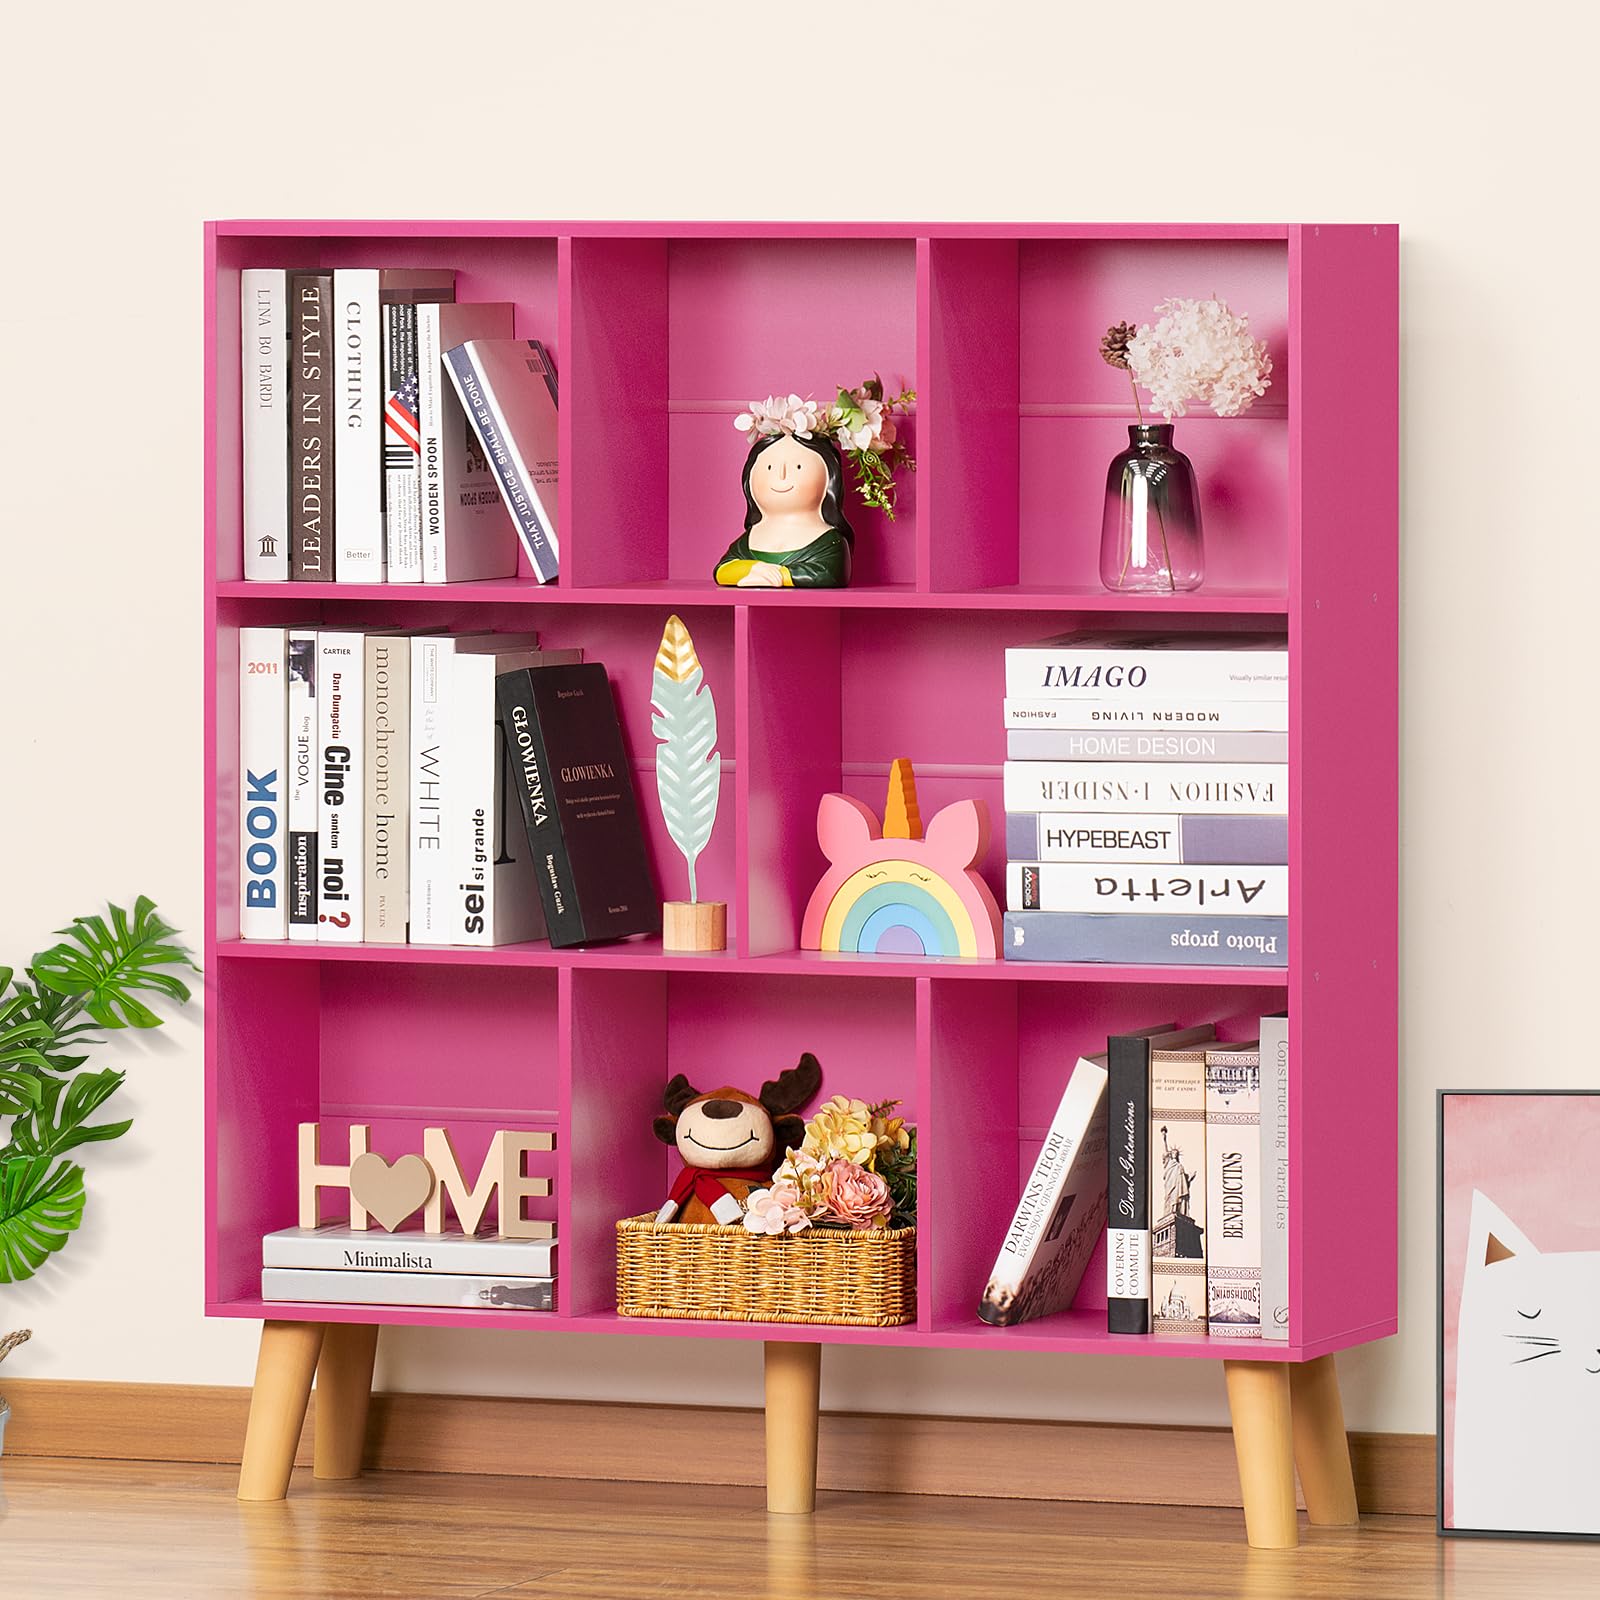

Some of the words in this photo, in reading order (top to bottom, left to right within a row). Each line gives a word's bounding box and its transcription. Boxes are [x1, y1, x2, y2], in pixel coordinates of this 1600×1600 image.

[257, 289, 270, 327] LINA
[258, 336, 272, 355] BO
[302, 286, 321, 379] STYLE
[346, 301, 362, 429] CLOTHING
[259, 363, 273, 409] BARDI
[463, 374, 483, 407] DONE
[303, 392, 321, 424] IN
[476, 407, 491, 426] BE
[426, 437, 438, 478] SPOON
[486, 427, 507, 464] SHALL
[303, 435, 321, 572] LEADERS
[428, 483, 439, 535] WOODEN
[504, 471, 531, 517] JUSTICE
[525, 519, 544, 549] THAT
[346, 550, 371, 559] Better
[247, 661, 278, 675] 2011
[323, 647, 351, 655] CARTIER
[331, 673, 342, 692] Dan
[1041, 665, 1148, 688] IMAGO
[1229, 674, 1252, 683] Visually
[301, 716, 311, 733] blog
[330, 694, 342, 739] Dungaciu
[376, 647, 395, 806] monochrome
[1091, 711, 1144, 721] LIVING
[1153, 712, 1220, 722] MODERN
[297, 736, 309, 786] VOGUE
[511, 705, 548, 825] GŁOWIENKA
[1069, 736, 1130, 755] HOME
[323, 745, 351, 805] Cine
[1170, 782, 1274, 802] FASHION
[419, 745, 440, 850] WHITE
[246, 768, 278, 908] BOOK
[376, 812, 395, 880] home
[474, 808, 488, 862] grande
[1046, 829, 1171, 849] HYPEBEAST
[294, 835, 311, 917] inspiration
[323, 858, 349, 900] noi
[473, 866, 484, 881] si
[1095, 877, 1267, 905] Arletta
[319, 911, 351, 928] ?
[459, 883, 484, 935] sei
[553, 890, 564, 914] Guzik
[1171, 929, 1220, 948] props
[1226, 934, 1278, 954] Photo
[1275, 1040, 1289, 1149] Constructing
[1005, 1179, 1043, 1254] DARWINS
[1035, 1131, 1065, 1179] TEORI
[1118, 1175, 1135, 1219] Duel
[1222, 1152, 1243, 1240] BENEDICTINS
[1276, 1158, 1289, 1230] Paradies
[343, 1250, 432, 1270] Minimalista
[1115, 1232, 1125, 1296] COVERING
[1129, 1233, 1139, 1296] COMMUTE
